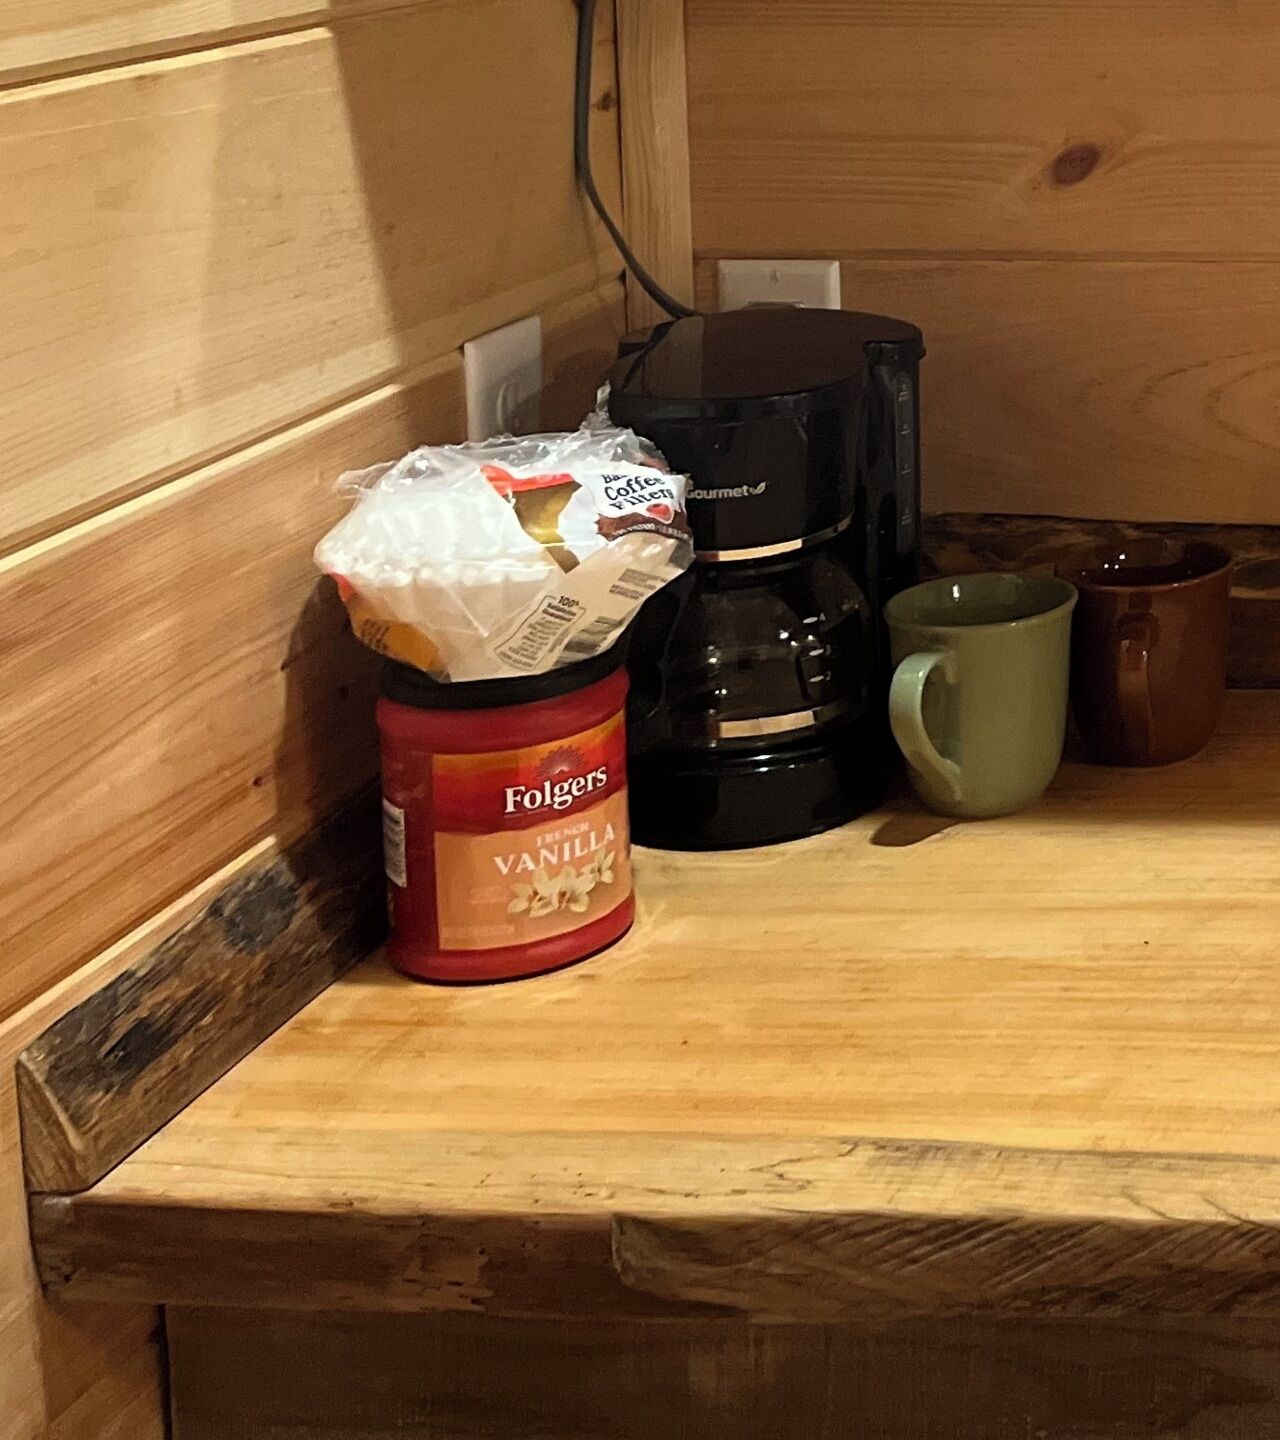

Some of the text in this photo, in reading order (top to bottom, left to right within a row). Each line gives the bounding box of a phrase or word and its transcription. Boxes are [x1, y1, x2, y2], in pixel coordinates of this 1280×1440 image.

[604, 476, 666, 501] Coffee
[608, 488, 674, 510] Filters
[504, 766, 607, 813] Folgers
[494, 823, 615, 876] VANILLA
